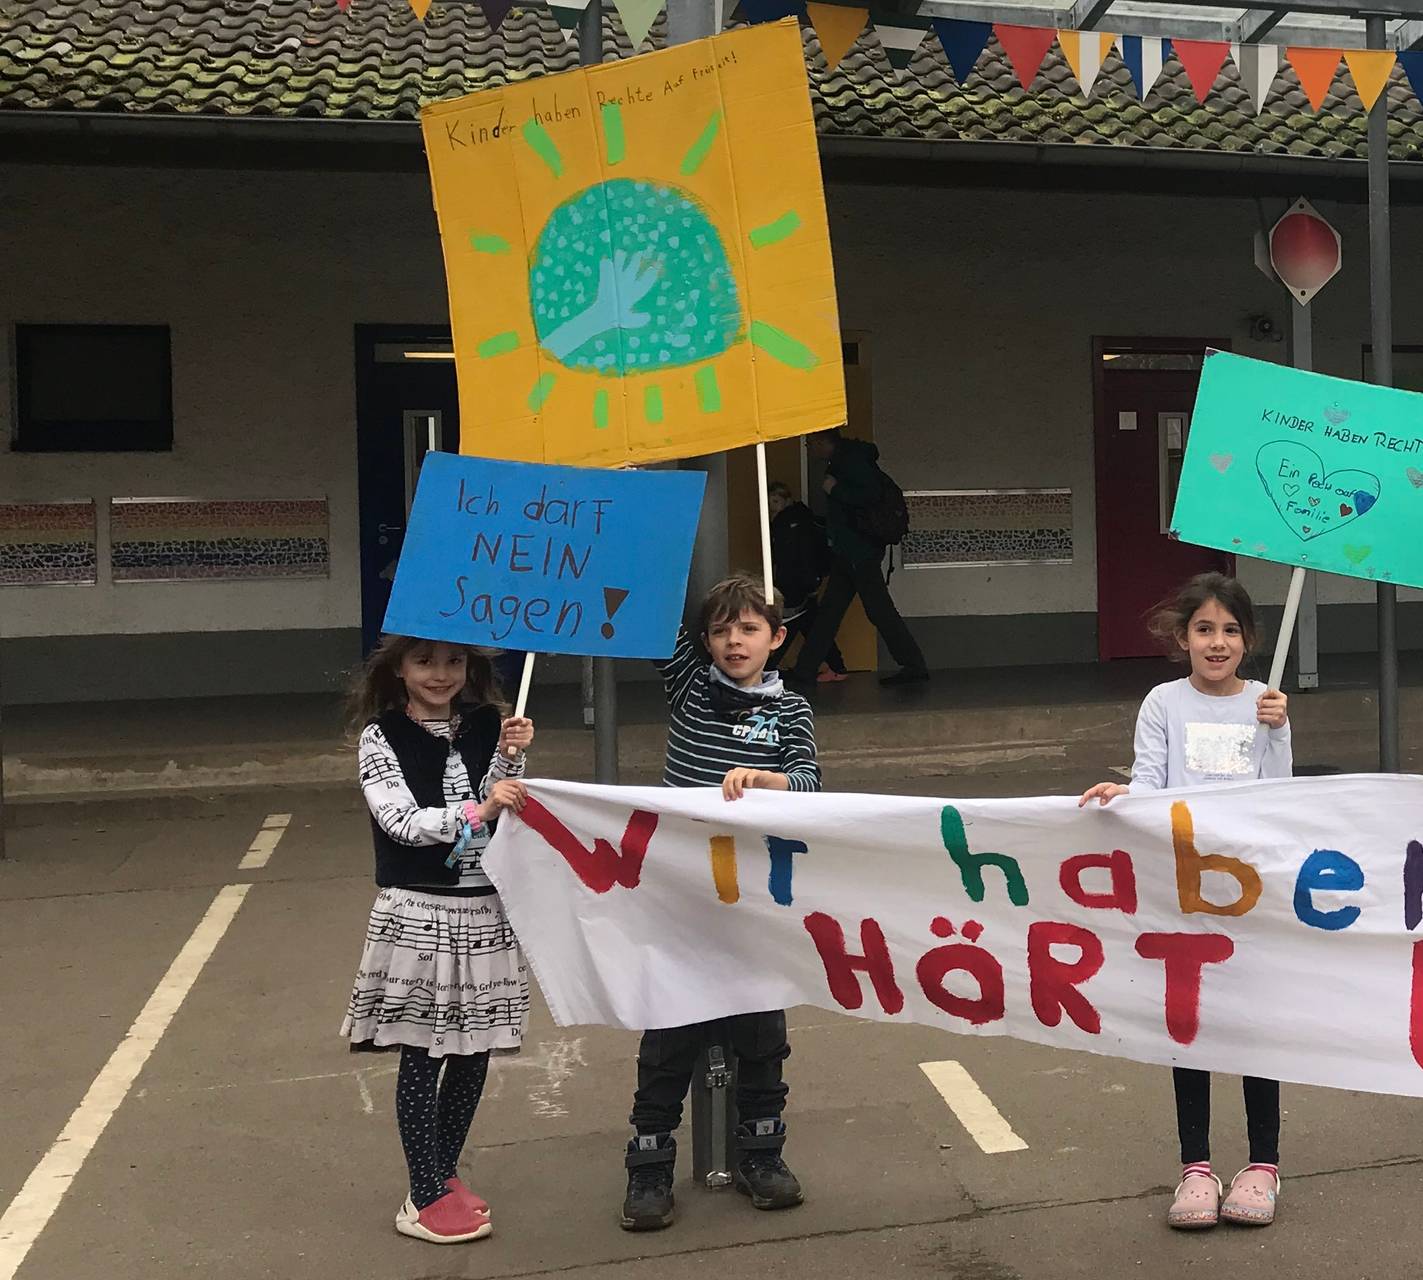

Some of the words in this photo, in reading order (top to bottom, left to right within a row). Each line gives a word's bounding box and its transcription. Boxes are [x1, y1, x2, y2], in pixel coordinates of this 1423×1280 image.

[445, 107, 516, 150] Kinder
[533, 93, 581, 126] haben
[597, 86, 653, 111] Rechte
[1261, 408, 1314, 433] KINDER
[1324, 424, 1370, 445] HABEN
[1278, 458, 1300, 478] Ein
[457, 478, 499, 515] Ich
[472, 532, 591, 579] NEIN
[417, 953, 433, 962] Sol
